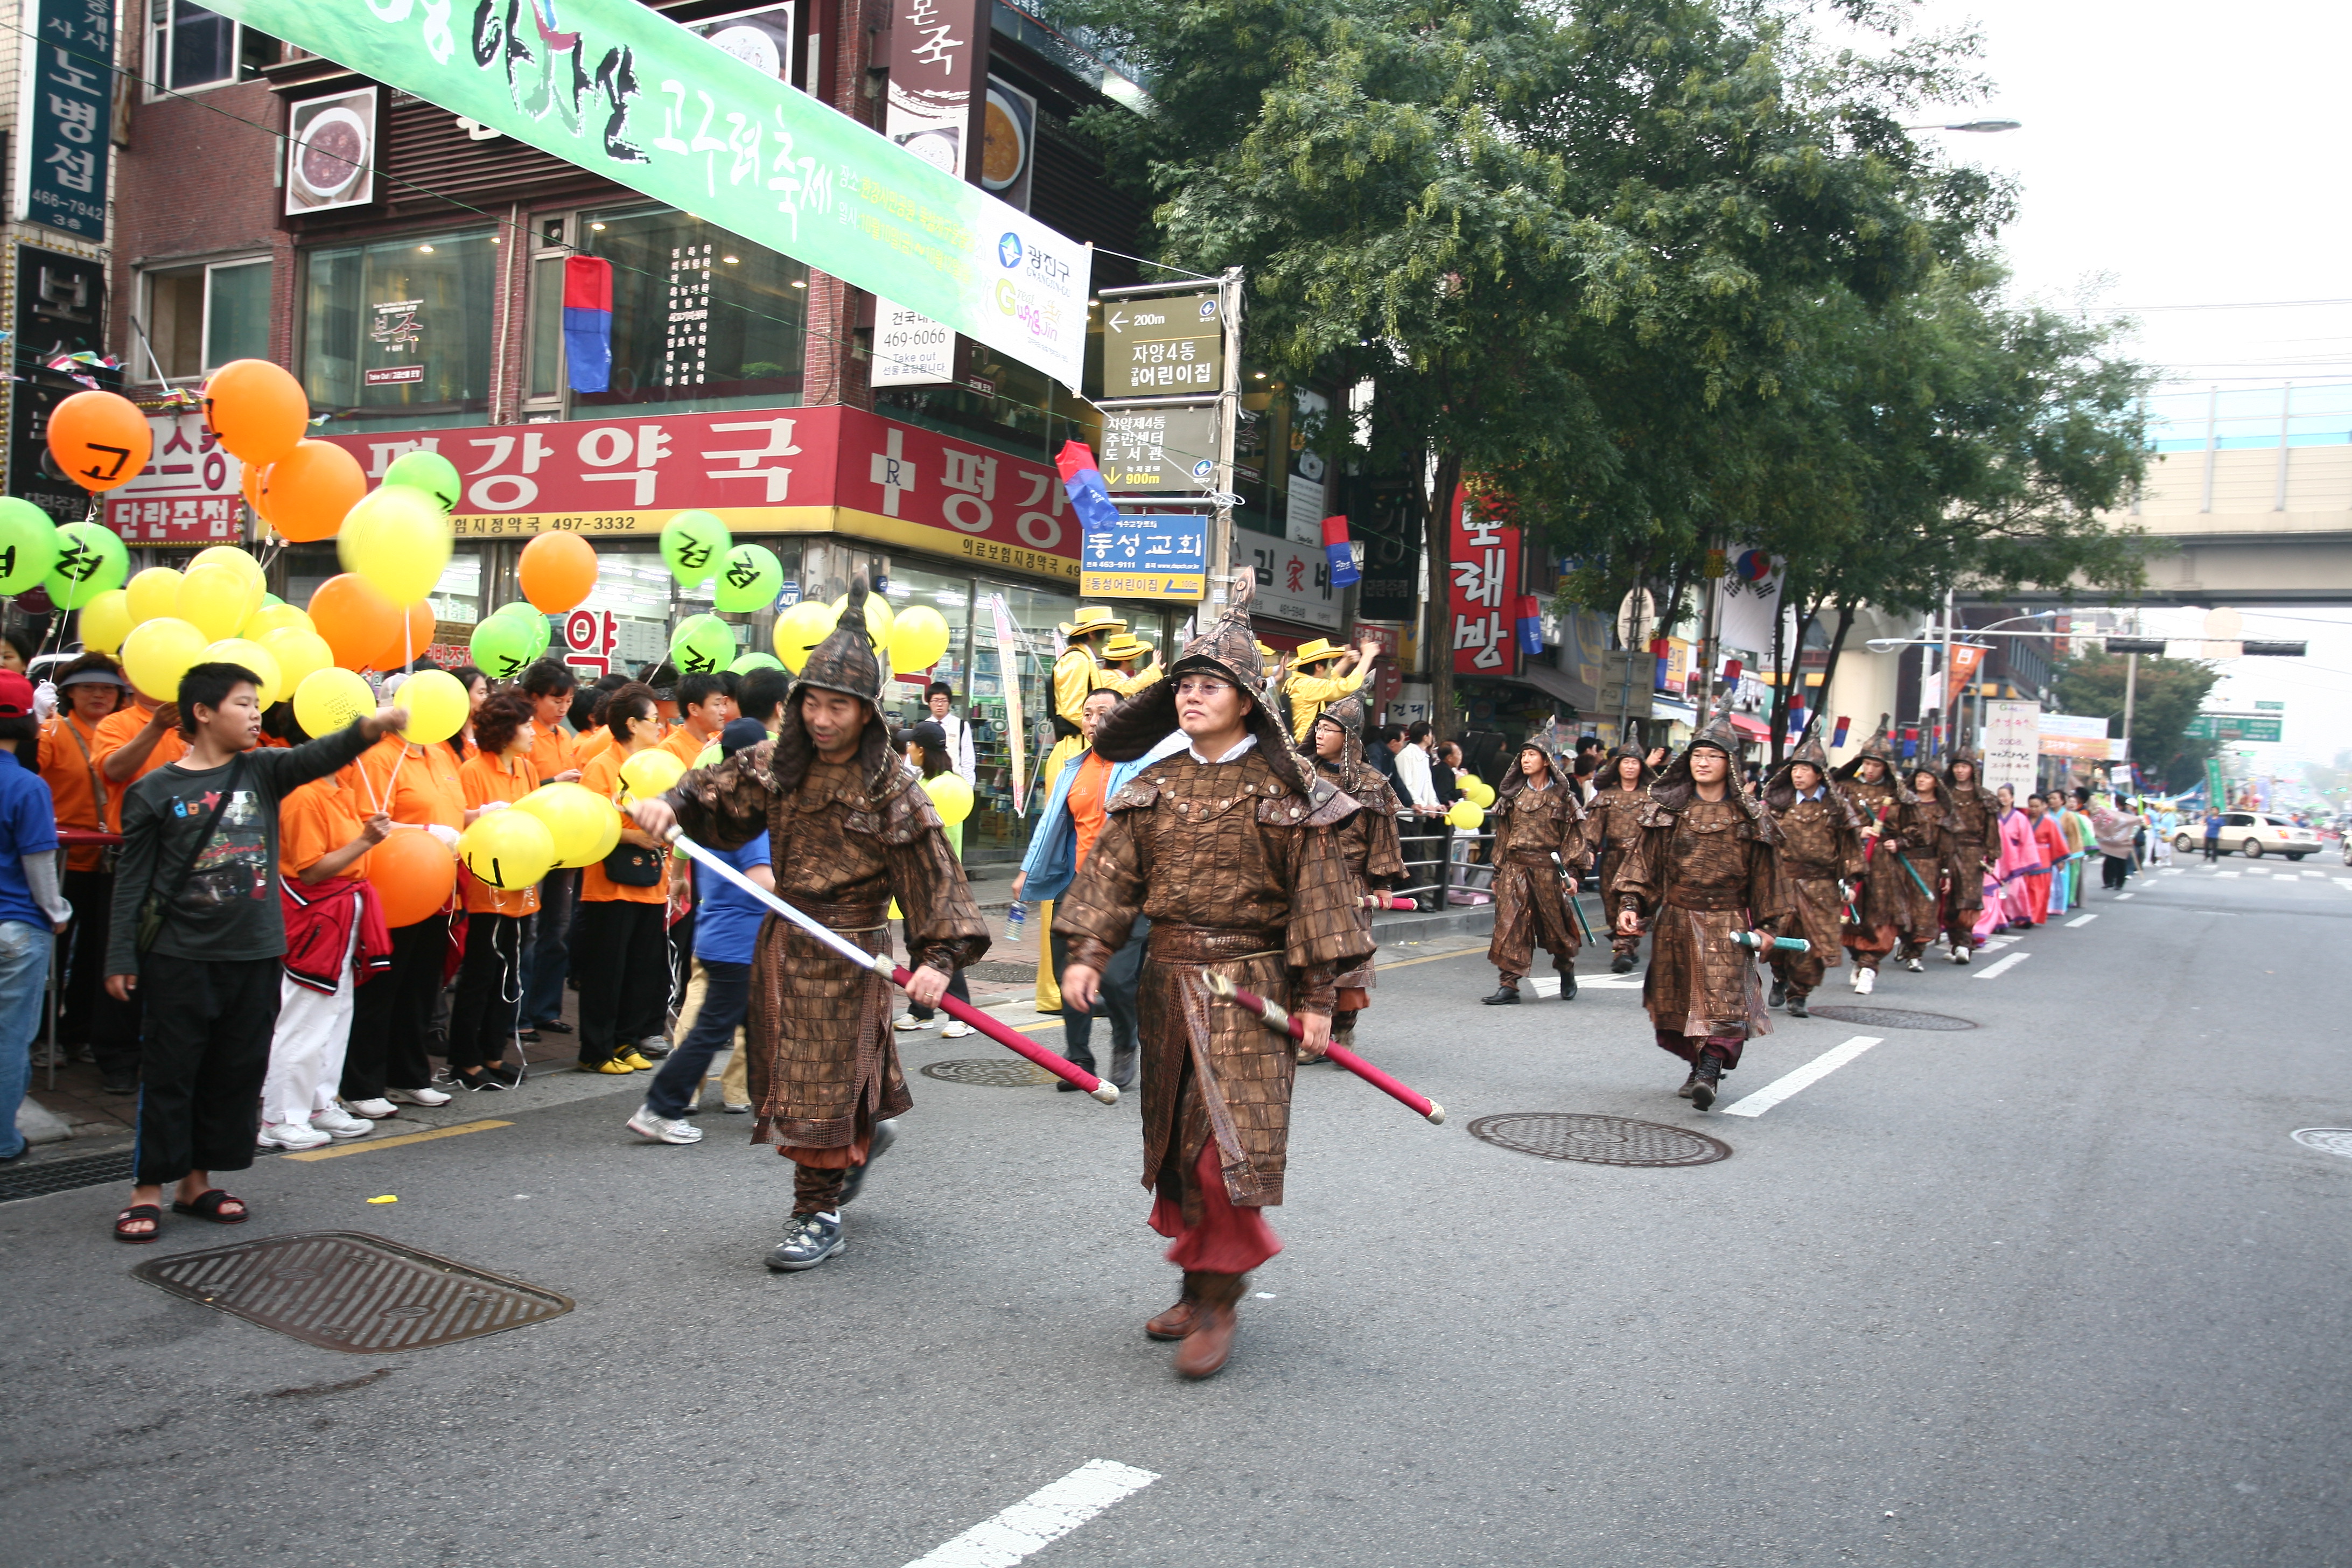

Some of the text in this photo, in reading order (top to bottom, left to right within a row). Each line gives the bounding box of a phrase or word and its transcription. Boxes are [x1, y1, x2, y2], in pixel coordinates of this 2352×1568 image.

[45, 47, 102, 194] 노병섭
[32, 188, 104, 222] 466-7942
[53, 214, 82, 230] 3층
[1027, 244, 1070, 283] 광진구
[1133, 314, 1165, 326] 200m
[370, 312, 424, 353] 본죽
[884, 327, 946, 347] 469-6066
[893, 352, 936, 363] Take out
[1132, 341, 1195, 363] 자양4동
[883, 366, 900, 375] 선물
[1139, 363, 1212, 386] 어린이집
[1107, 416, 1166, 430] 자양제4동
[1105, 431, 1164, 447] 주민센터
[1125, 473, 1160, 484] 900m
[115, 499, 229, 538] 단란주점
[552, 516, 635, 530] 497-3332
[1087, 532, 1201, 559] 동성교회
[962, 539, 1059, 573] 의료보험지정약국
[1091, 577, 1158, 593] 동성어린이집
[1450, 501, 1508, 669] 노래방
[779, 593, 799, 606] ADT
[1392, 703, 1424, 720] 건대
